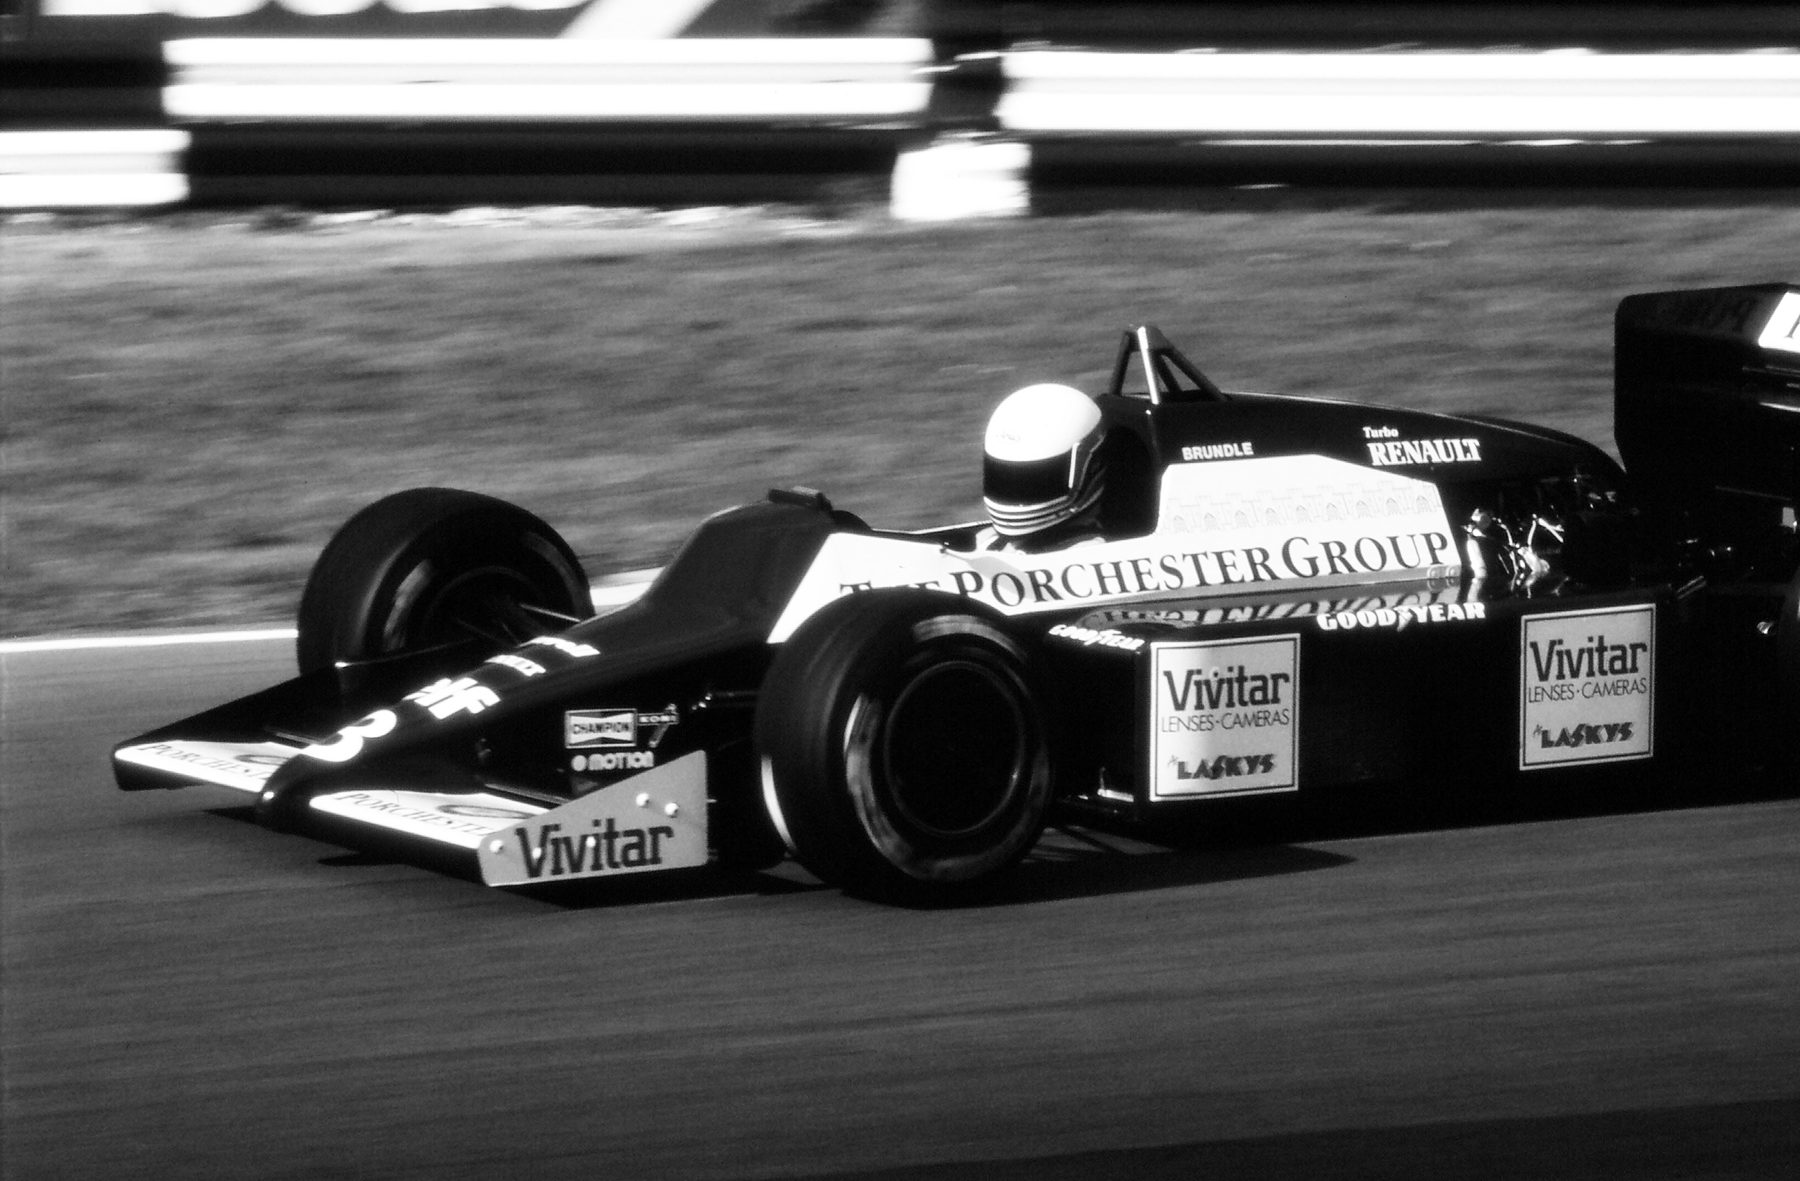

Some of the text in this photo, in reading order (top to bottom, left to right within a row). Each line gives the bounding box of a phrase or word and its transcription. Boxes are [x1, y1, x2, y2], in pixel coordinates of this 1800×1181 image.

[1362, 426, 1399, 439] Turbo
[1181, 442, 1254, 461] BRUNDLE
[1366, 438, 1482, 466] RENAULT
[1316, 602, 1486, 632] GOODYEAR
[1529, 635, 1648, 682] Vivitar
[1163, 665, 1290, 711] Vivitar
[573, 721, 630, 735] CHAMPION
[1541, 721, 1635, 749] LASKYS
[1177, 753, 1277, 780] LASKYS
[516, 818, 675, 878] Vivitar
